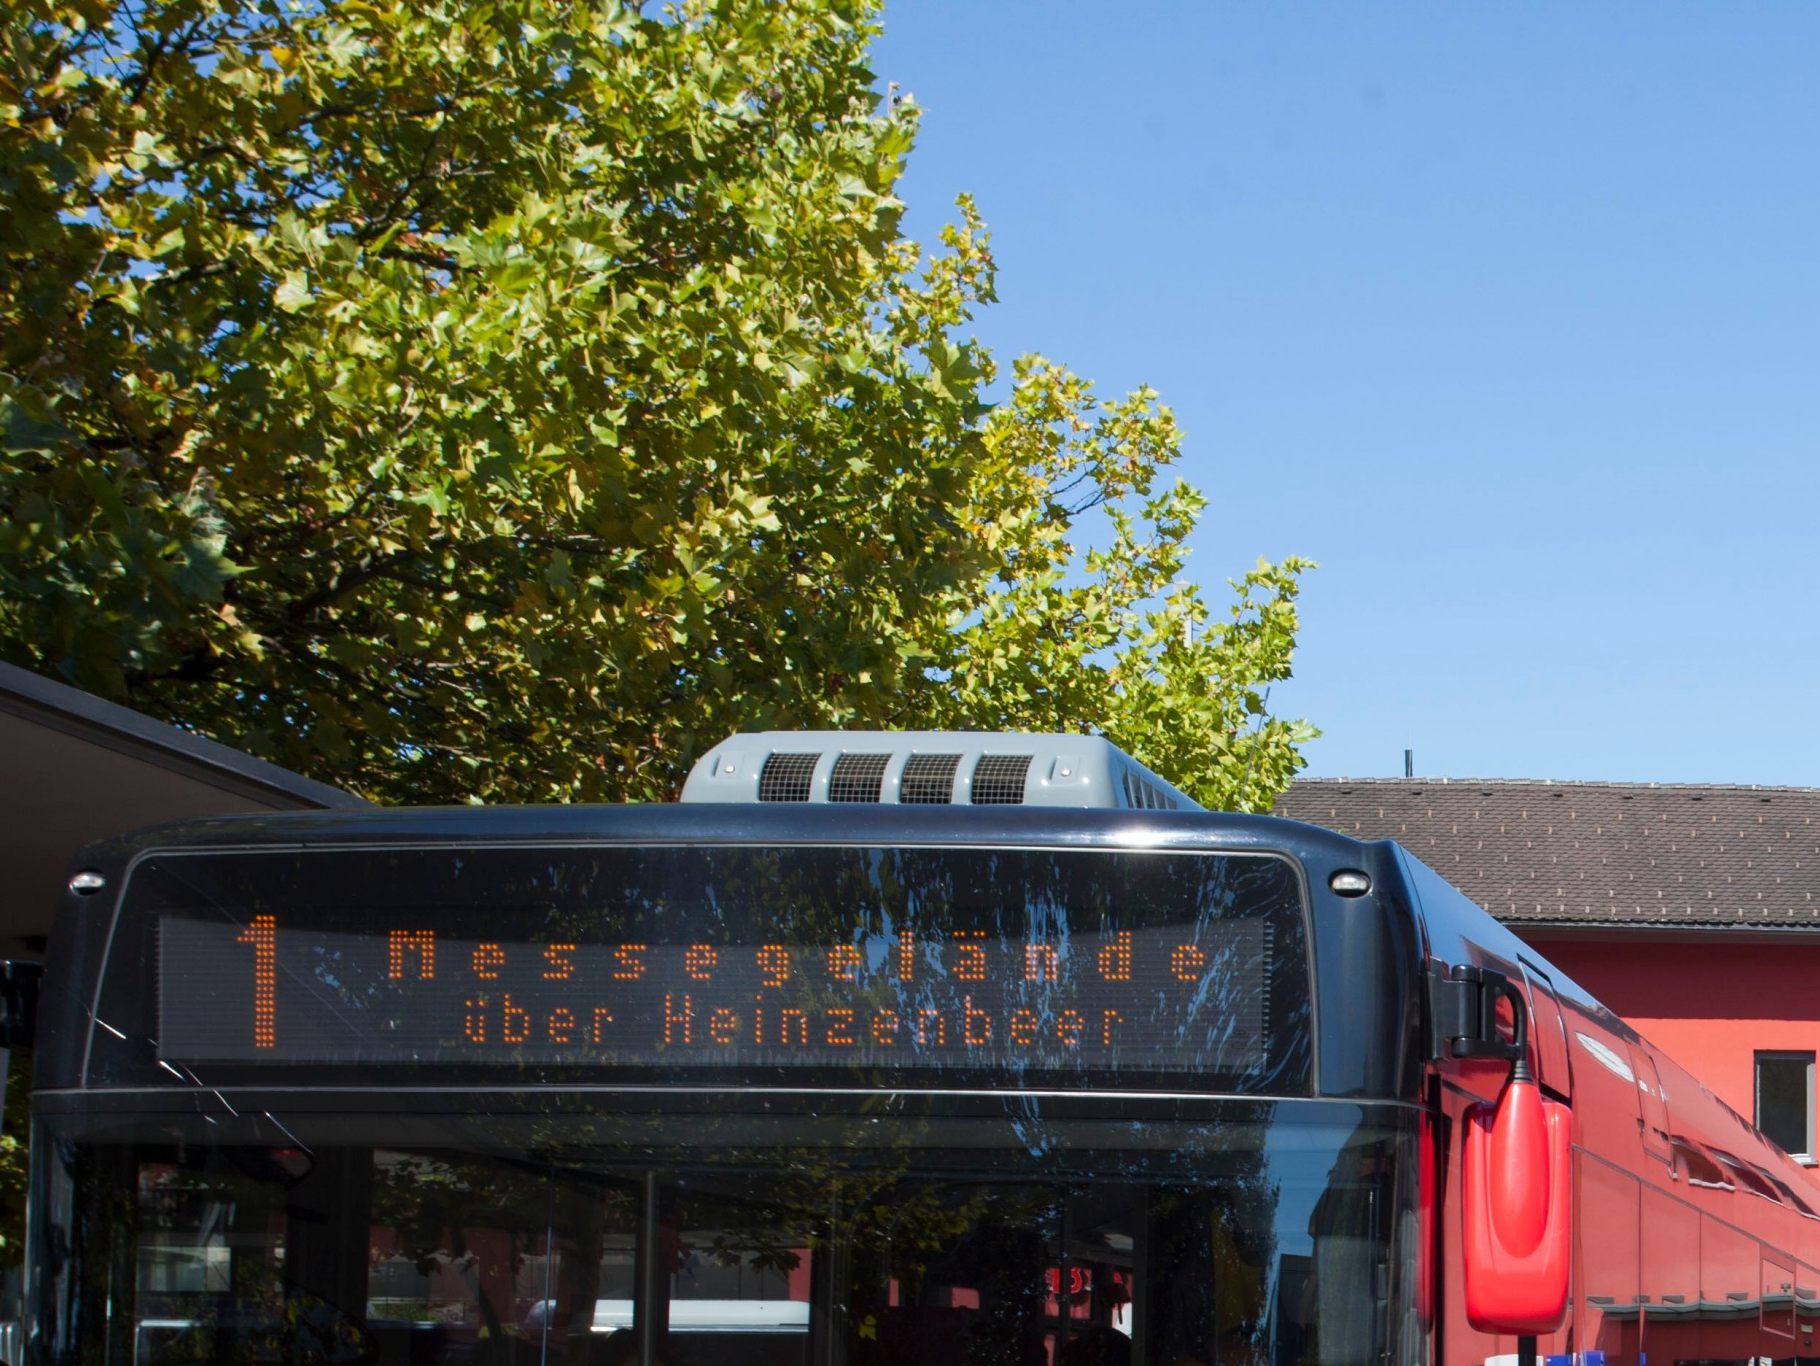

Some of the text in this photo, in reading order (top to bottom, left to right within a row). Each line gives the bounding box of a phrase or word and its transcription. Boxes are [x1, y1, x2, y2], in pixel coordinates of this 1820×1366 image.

[237, 914, 278, 1048] 1
[388, 929, 1205, 988] Messegelände
[464, 993, 1125, 1046] über Heinzenbeer
